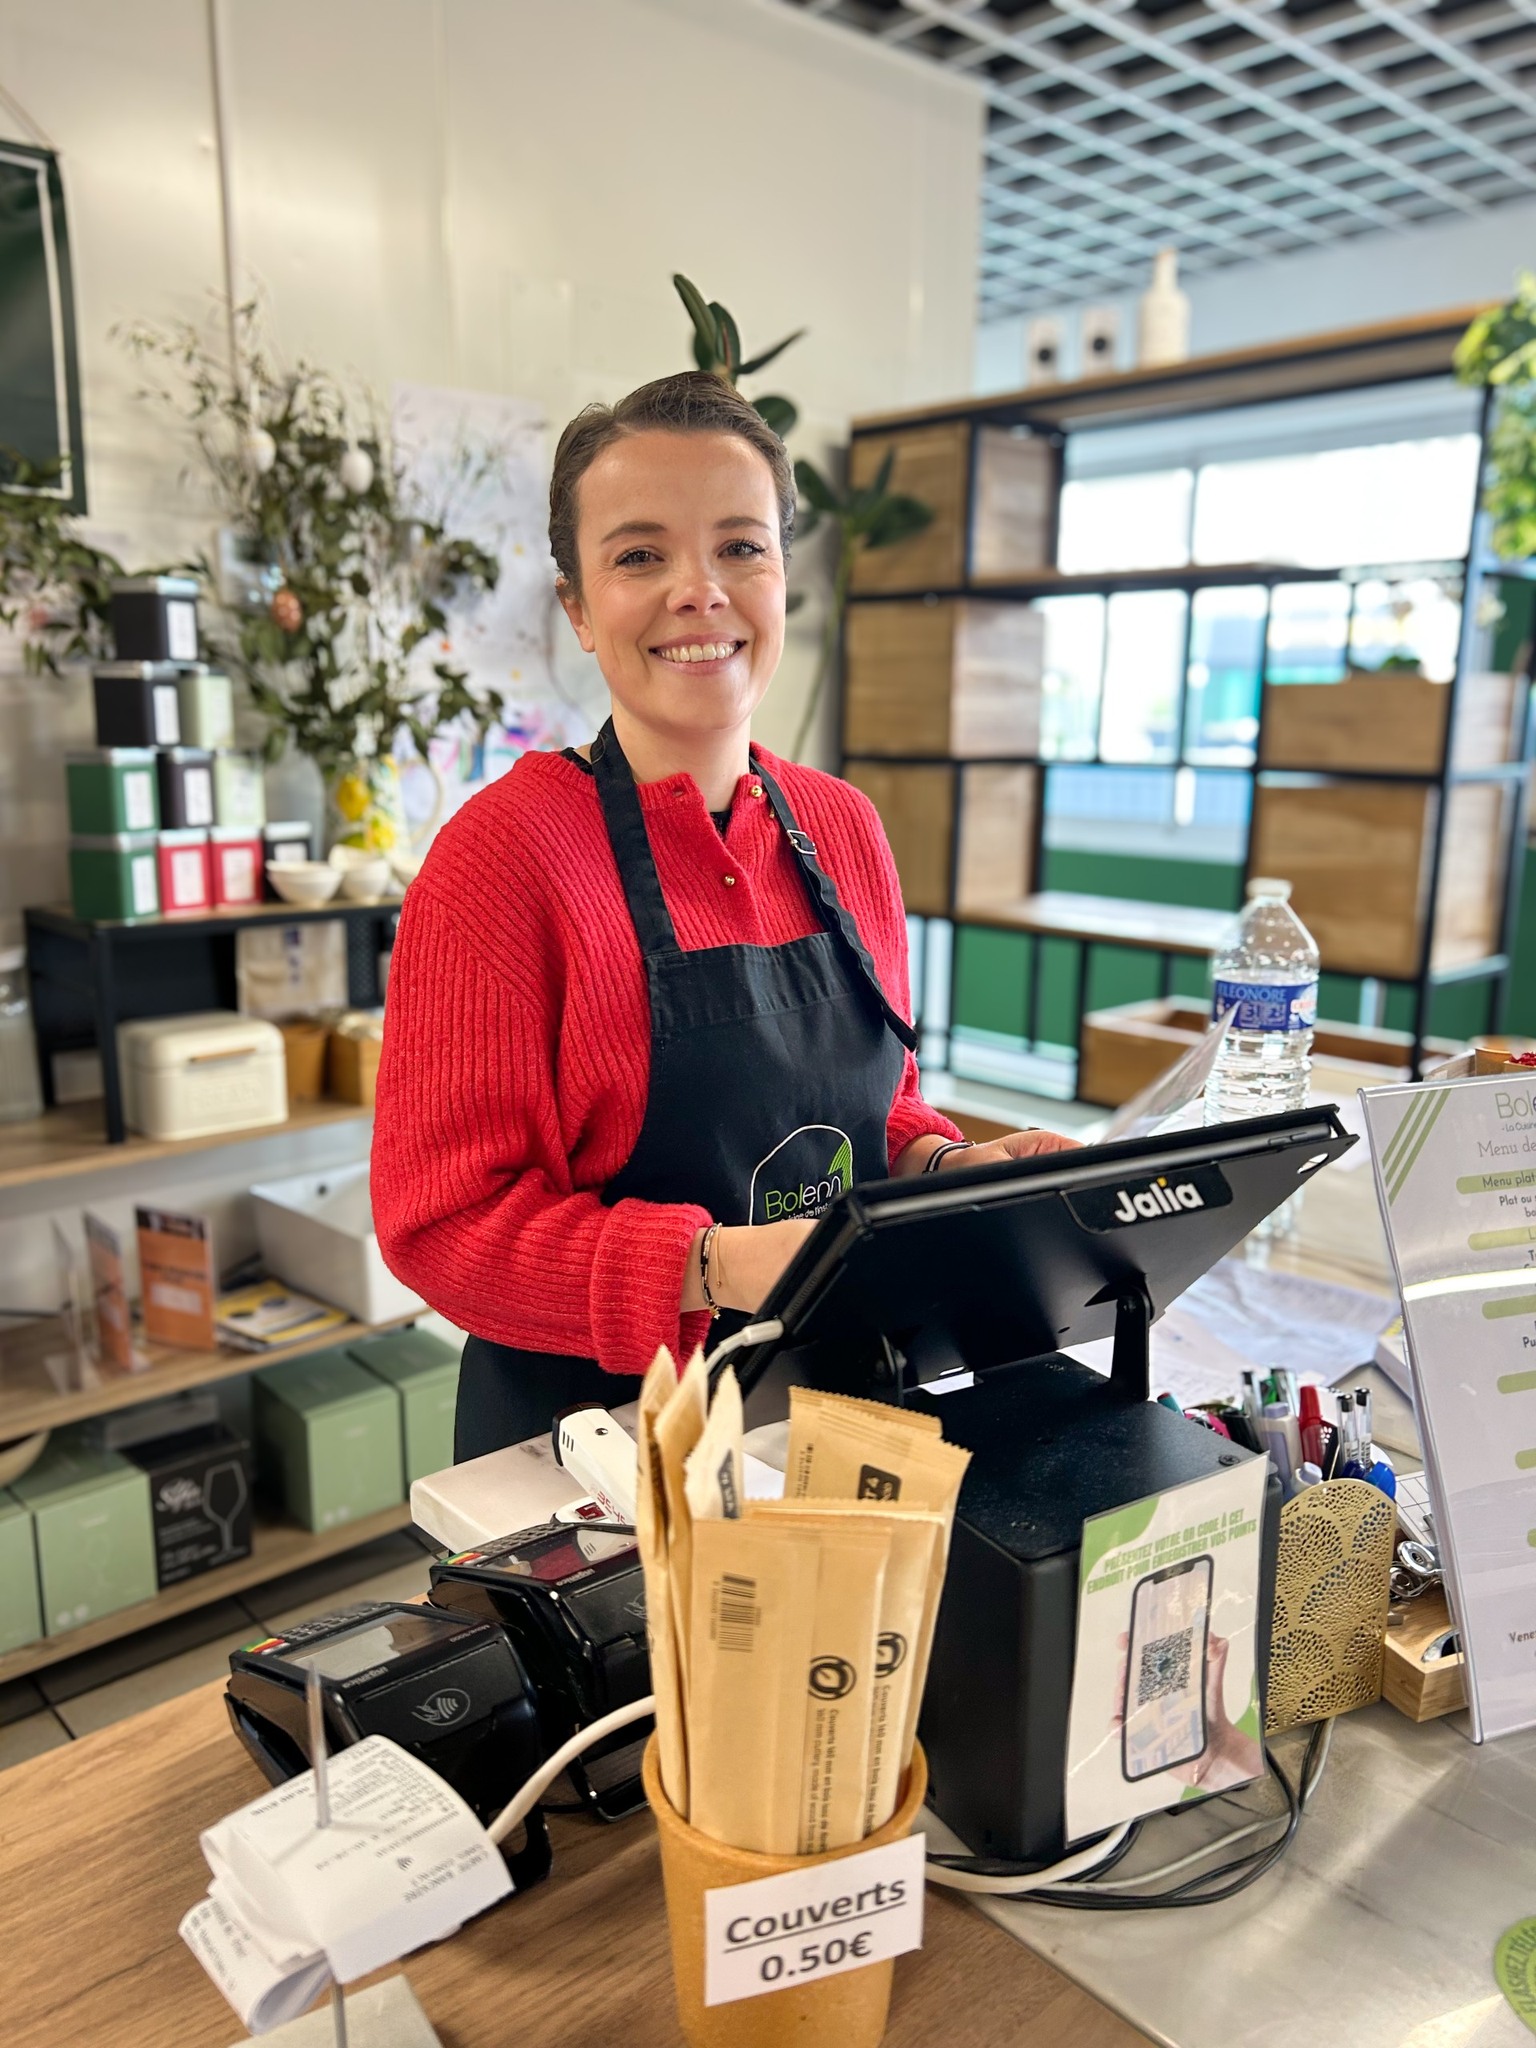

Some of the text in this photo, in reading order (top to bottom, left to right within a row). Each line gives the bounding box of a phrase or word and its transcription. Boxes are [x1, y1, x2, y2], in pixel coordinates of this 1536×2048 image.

[1477, 1140, 1518, 1157] Menu
[765, 1175, 841, 1219] Bolenn
[1114, 1176, 1205, 1223] Jalia
[1482, 1175, 1512, 1189] Menu
[1499, 1194, 1518, 1206] Plat
[1521, 1195, 1532, 1204] ou
[1154, 1531, 1181, 1553] VOTRE
[1182, 1526, 1195, 1542] QR
[1197, 1517, 1220, 1537] CODE
[1229, 1509, 1245, 1525] CET
[1087, 1568, 1125, 1594] ENDROIT
[1127, 1557, 1151, 1580] POUR
[1210, 1530, 1227, 1548] VOS
[1228, 1519, 1257, 1541] POINTS
[726, 1879, 906, 1944] Couverts
[760, 1931, 873, 1982] 0.50€
